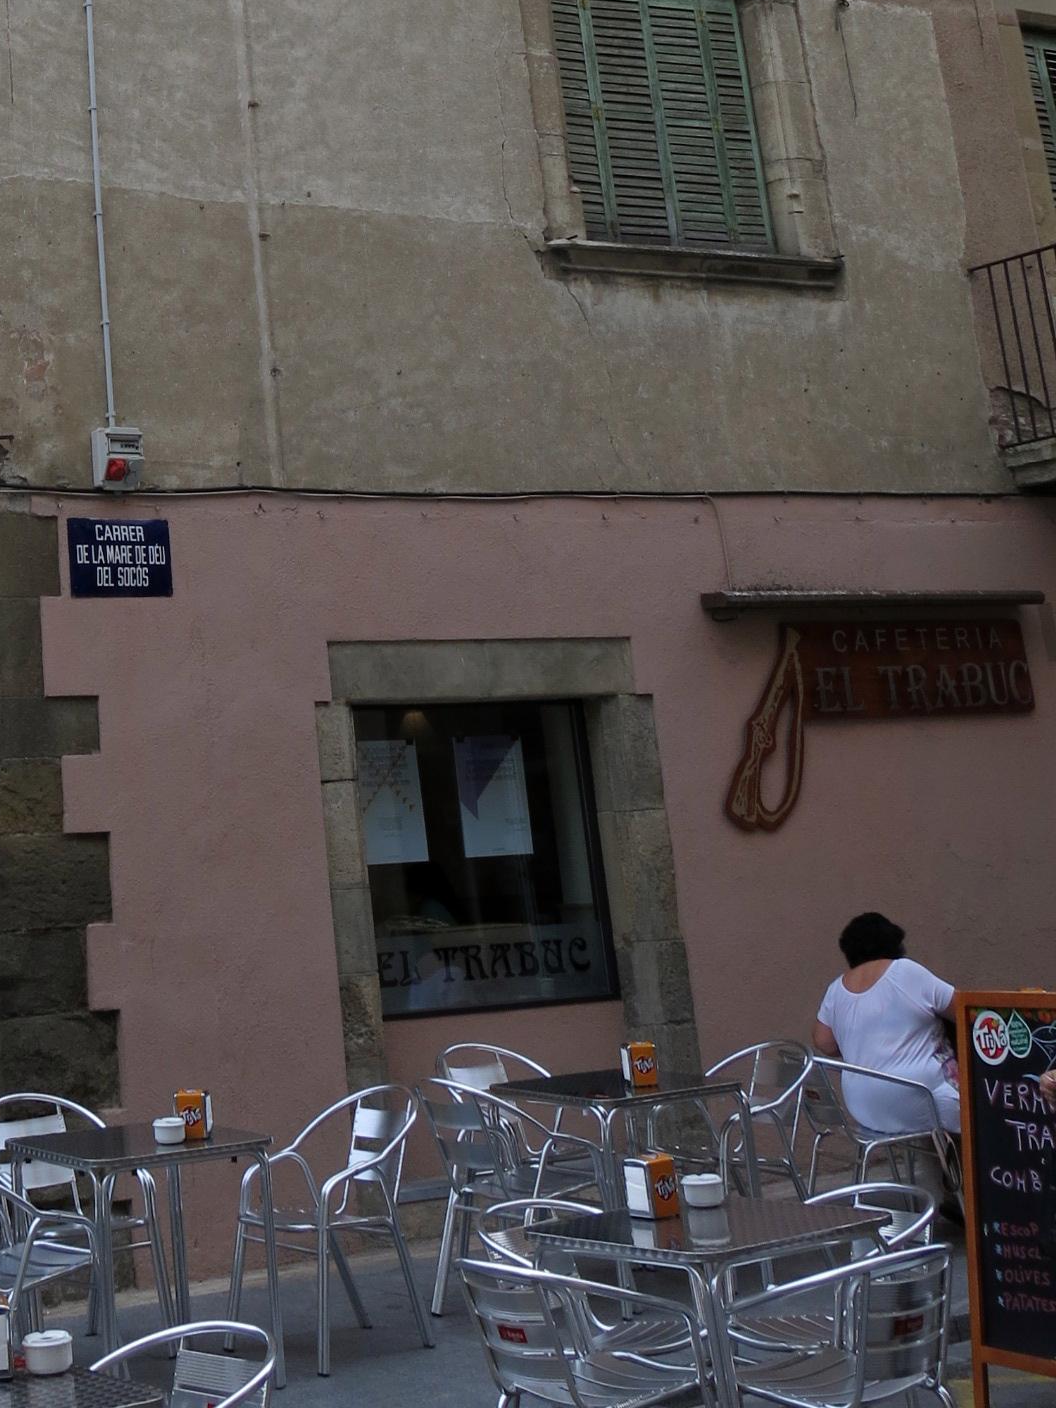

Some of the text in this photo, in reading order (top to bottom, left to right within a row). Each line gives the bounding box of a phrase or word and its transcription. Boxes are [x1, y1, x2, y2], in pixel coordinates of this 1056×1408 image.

[95, 524, 145, 542] CARRER
[76, 543, 166, 565] DE LA MARE DE DÉU
[96, 566, 115, 587] DEL
[831, 626, 1003, 654] CAFETERIA
[814, 659, 1034, 713] EL TRABUC
[377, 936, 592, 987] EL TRABUC
